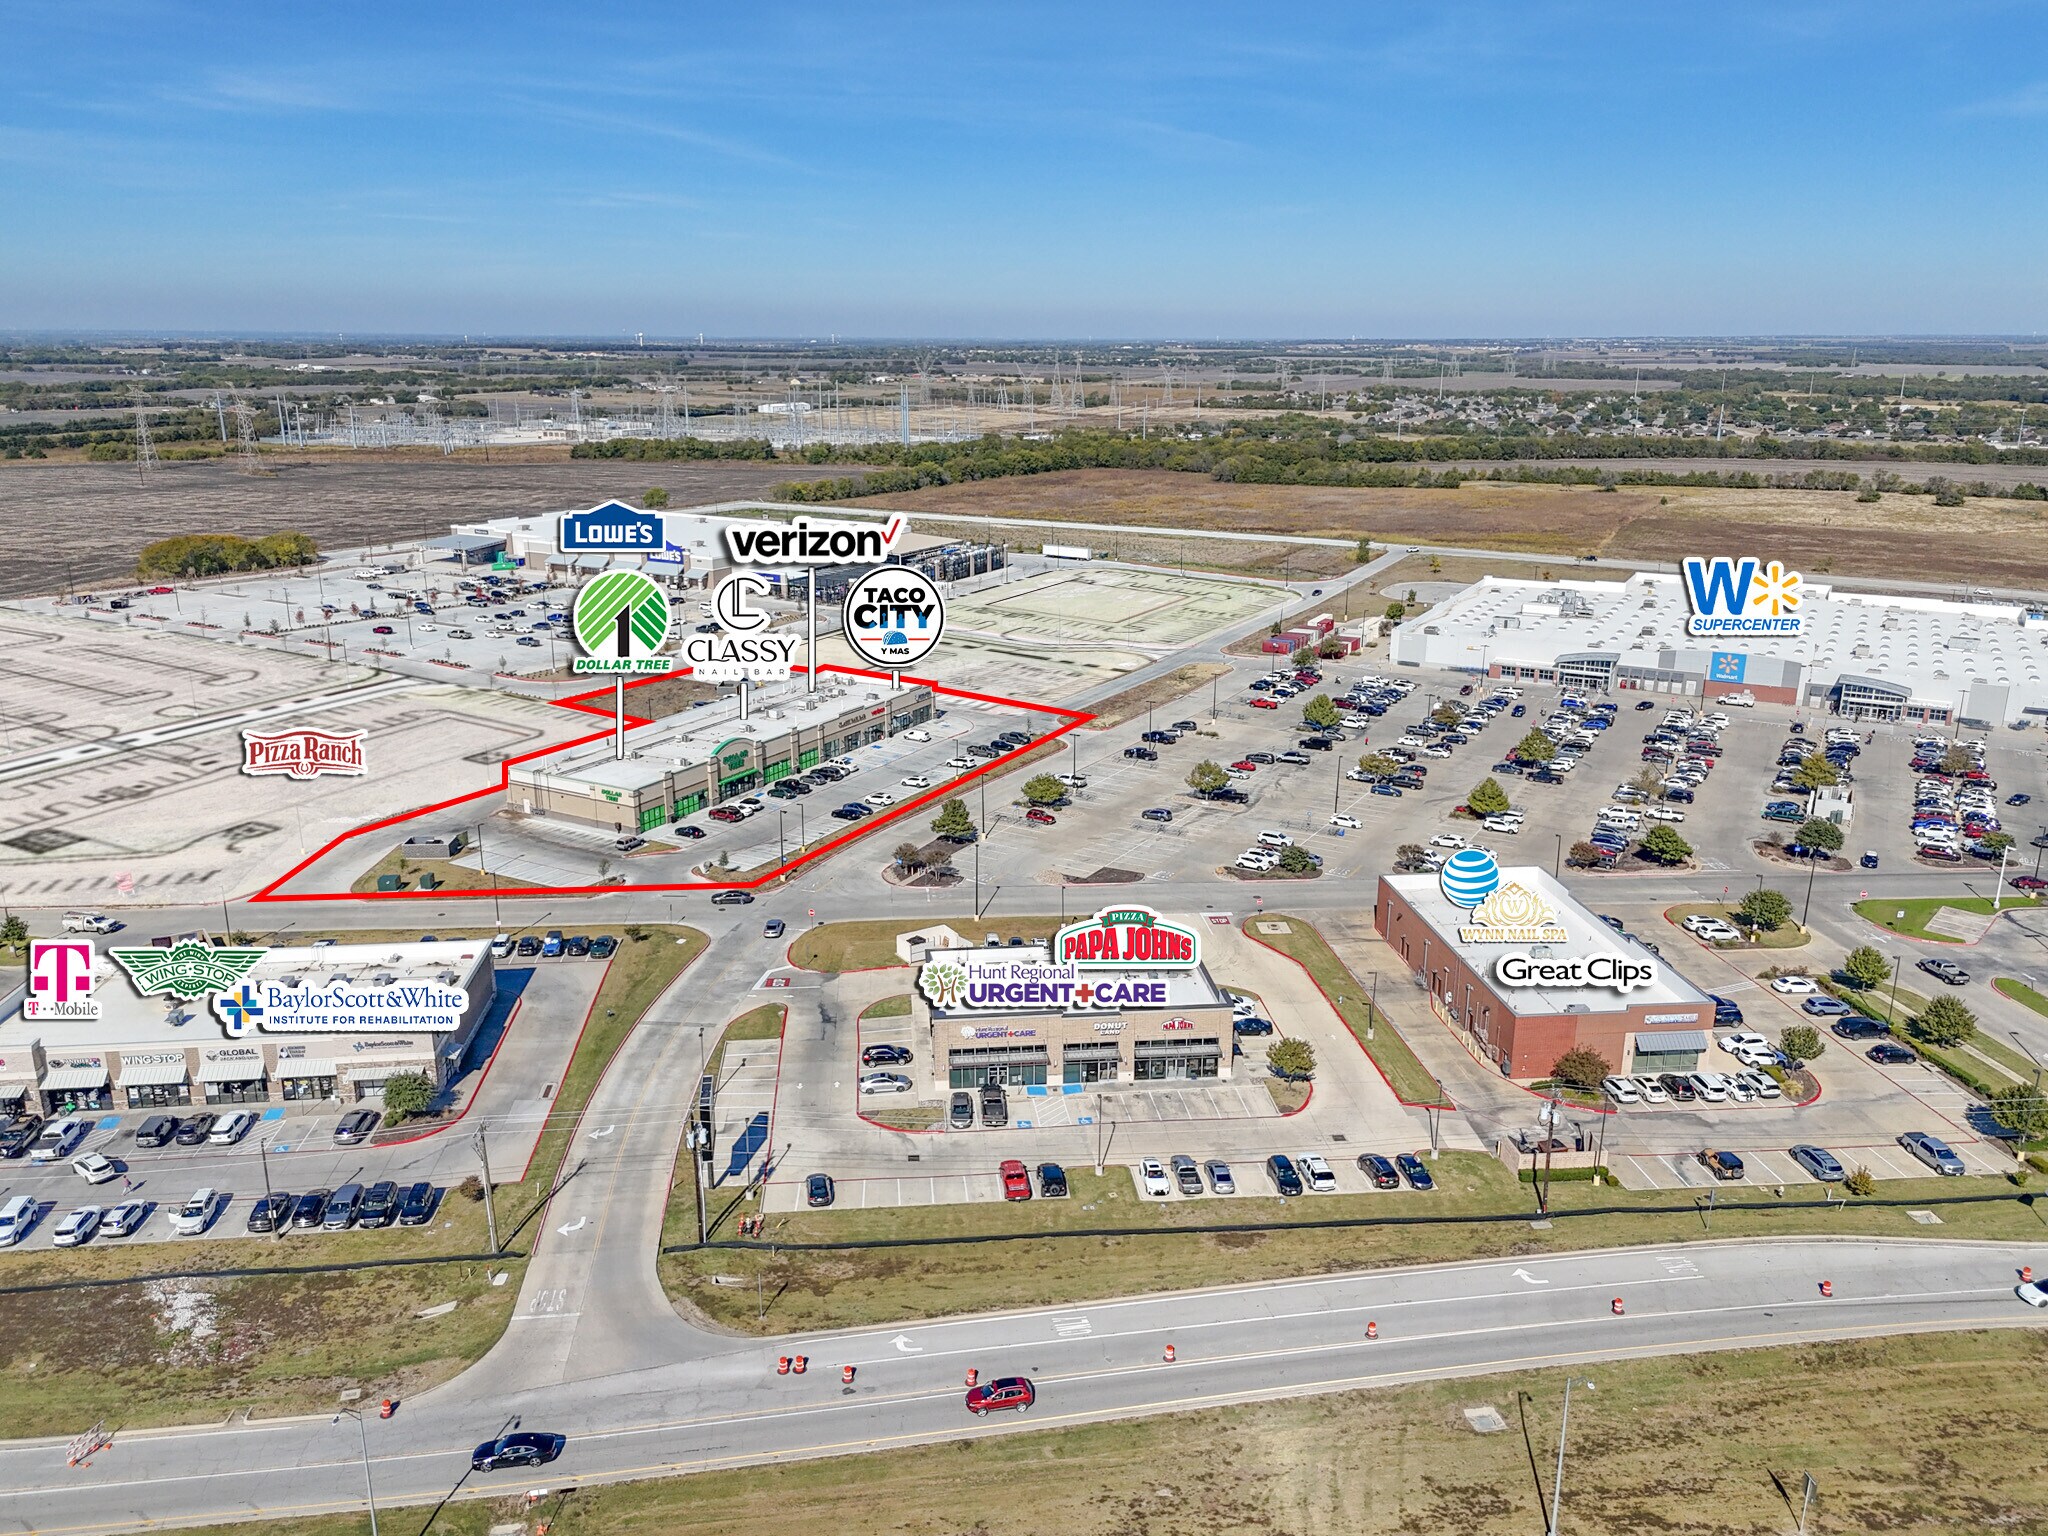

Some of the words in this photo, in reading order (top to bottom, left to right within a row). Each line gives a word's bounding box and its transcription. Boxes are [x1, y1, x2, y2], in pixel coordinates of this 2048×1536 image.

[1715, 673, 1738, 681] Walmart
[722, 749, 749, 766] DOLLAR
[1093, 1021, 1128, 1030] DONUT
[219, 1048, 258, 1056] GLOBAL
